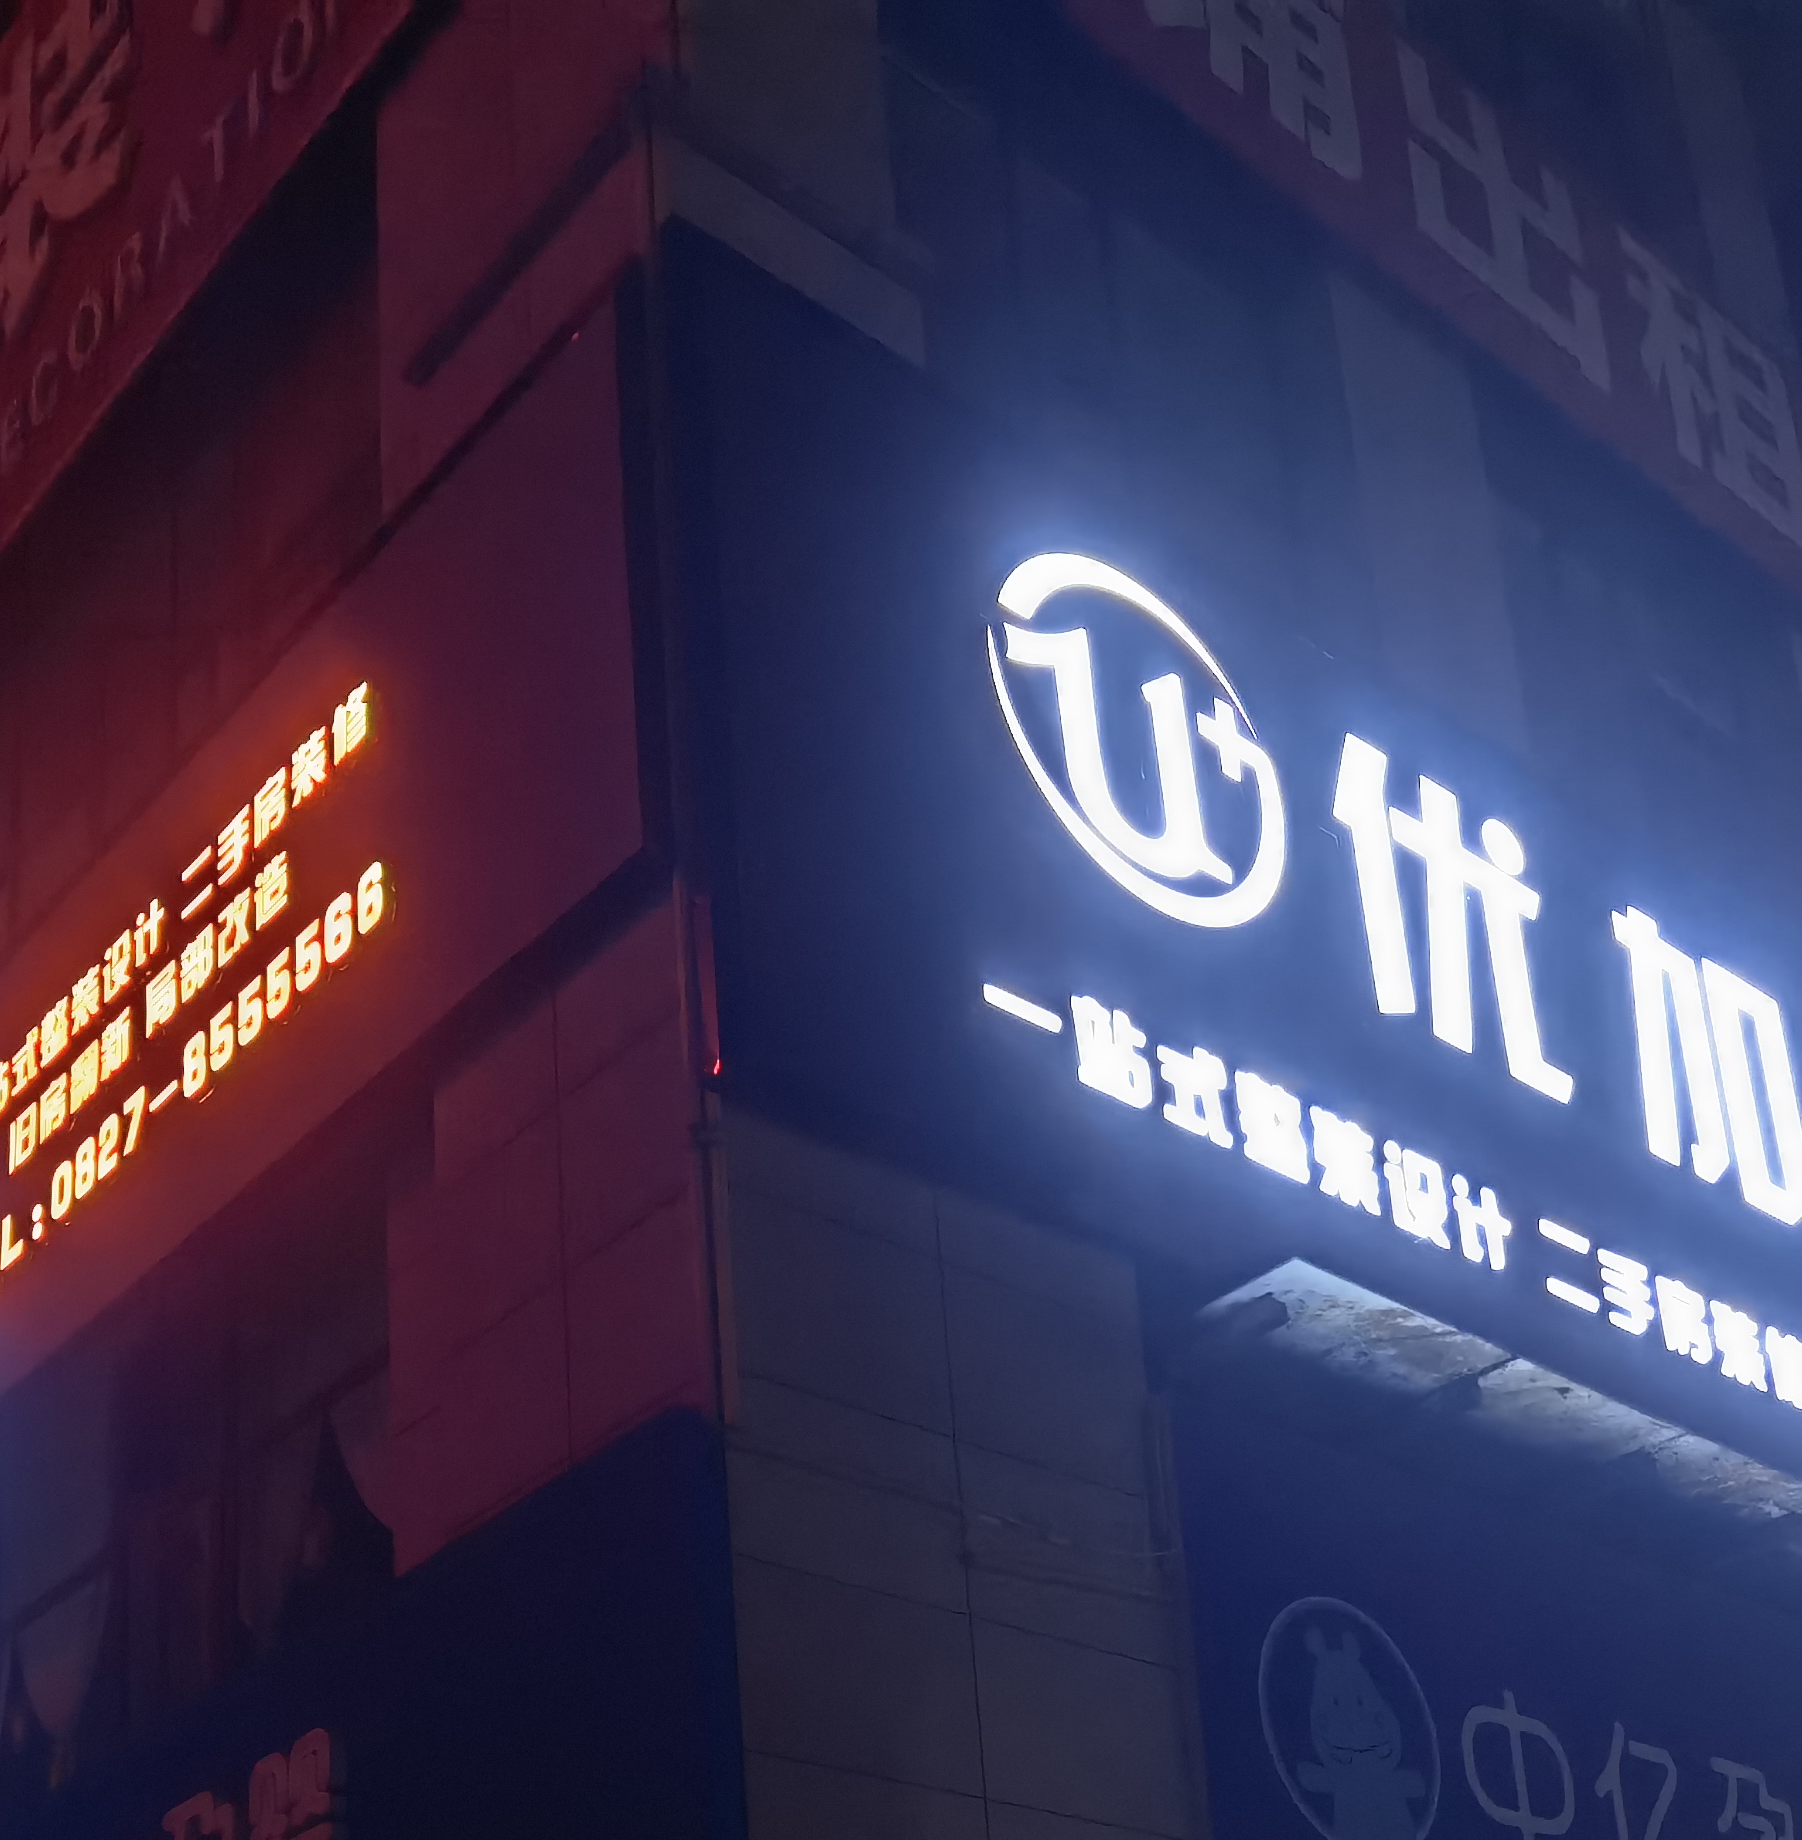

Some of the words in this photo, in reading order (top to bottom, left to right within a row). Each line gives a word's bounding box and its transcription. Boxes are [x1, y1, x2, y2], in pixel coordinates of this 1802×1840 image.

[181, 681, 371, 920] 二手房装修
[8, 1007, 132, 1175] 旧房翻新
[145, 851, 290, 1038] 局部改造
